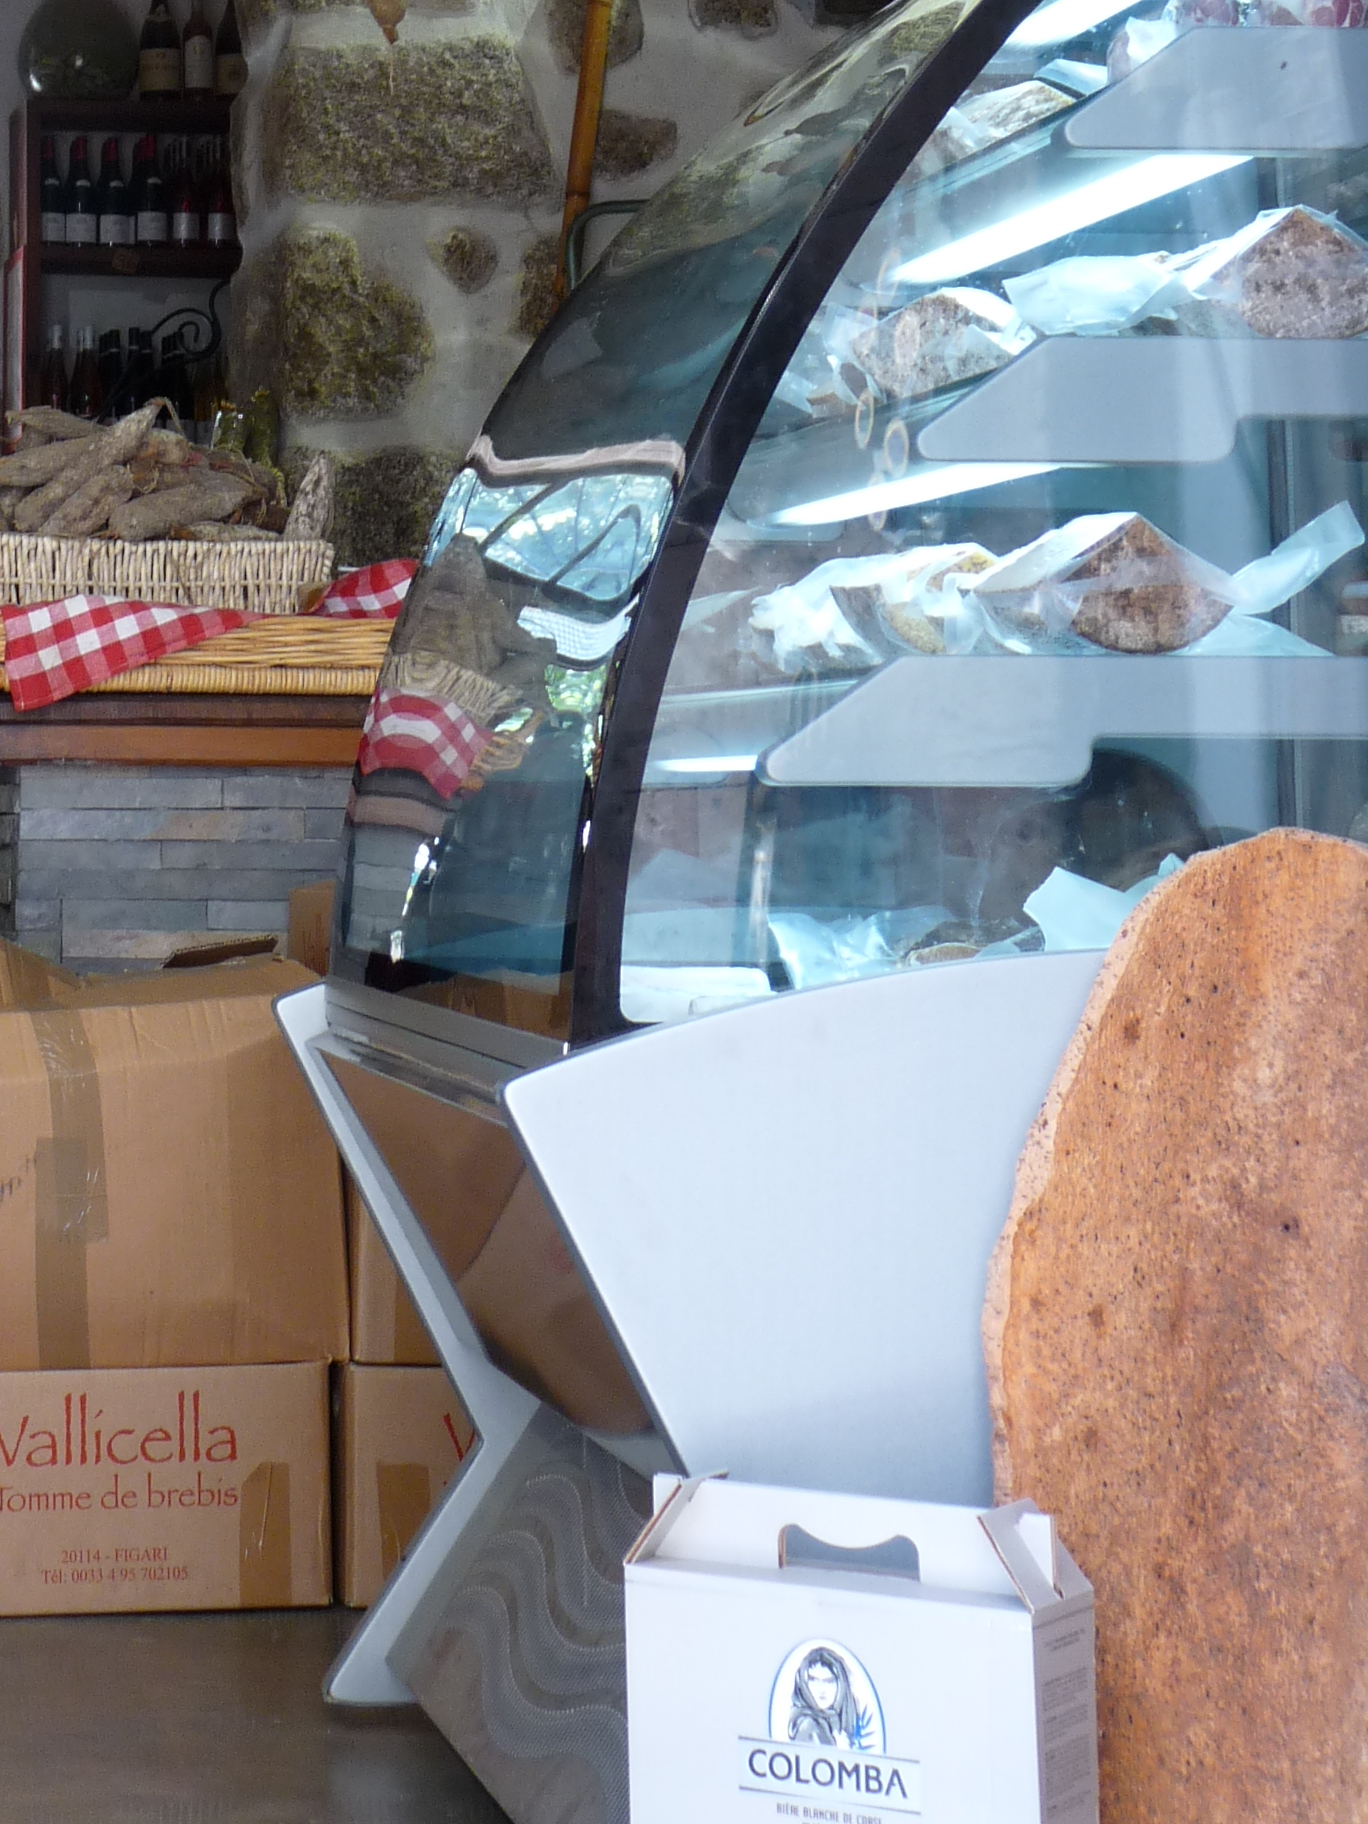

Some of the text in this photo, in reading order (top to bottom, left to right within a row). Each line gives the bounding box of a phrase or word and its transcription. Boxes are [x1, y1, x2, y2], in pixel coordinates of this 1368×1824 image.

[100, 1473, 138, 1510] de
[147, 1471, 238, 1509] brebis
[61, 1549, 101, 1564] 20114
[114, 1547, 168, 1563] FIGARI
[71, 1568, 104, 1583] 0033
[108, 1568, 115, 1582] 4
[120, 1567, 140, 1582] 95
[142, 1565, 189, 1581] 702105
[748, 1748, 908, 1799] COLOMBA
[803, 1806, 839, 1823] BLANCHE
